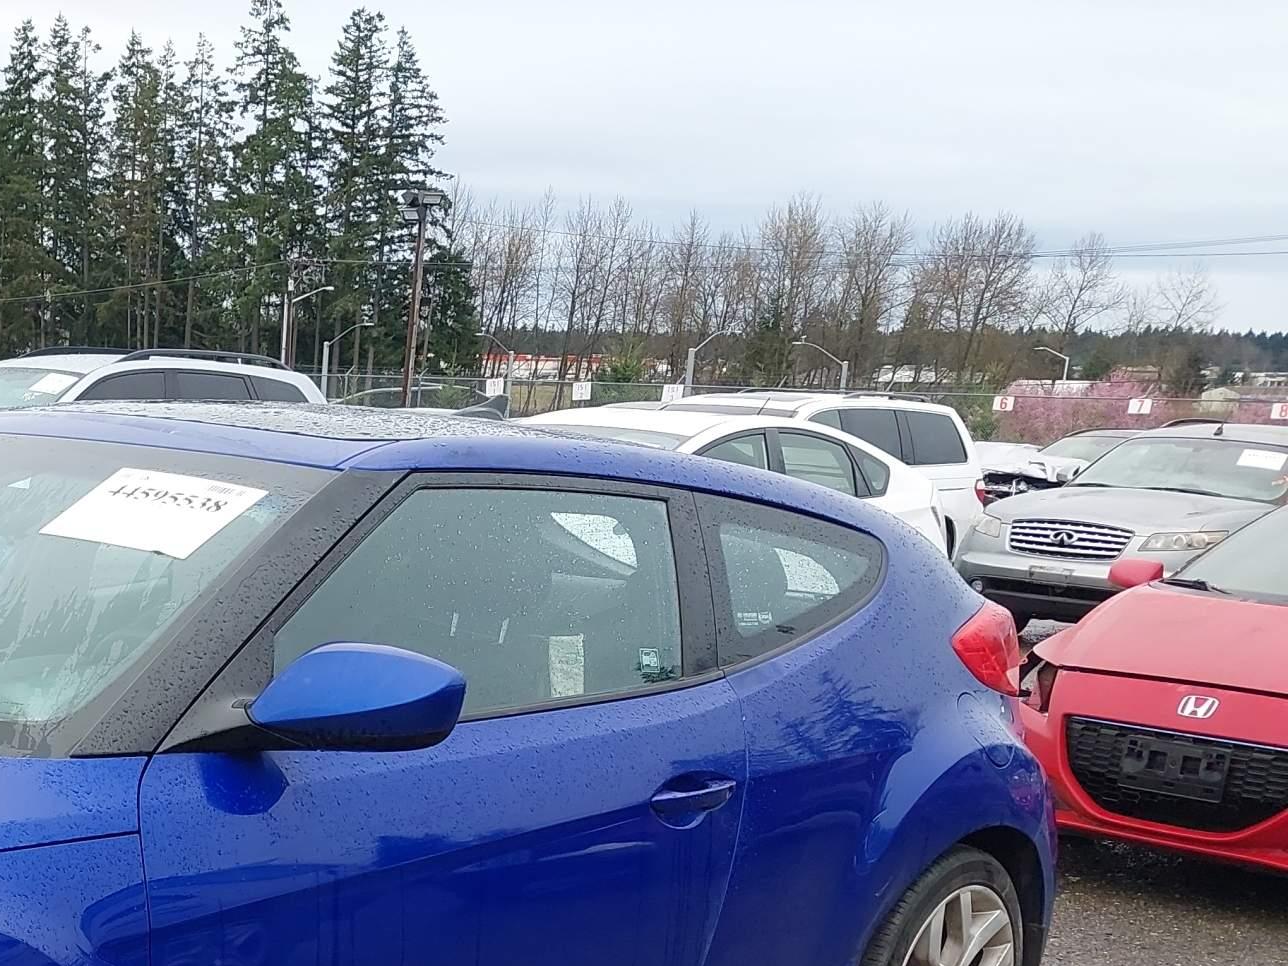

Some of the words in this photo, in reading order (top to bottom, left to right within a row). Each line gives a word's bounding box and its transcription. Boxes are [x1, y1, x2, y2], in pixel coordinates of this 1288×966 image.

[999, 397, 1008, 410] 6
[1136, 399, 1145, 413] 7
[1279, 404, 1288, 418] 8
[108, 484, 228, 512] 44595538
